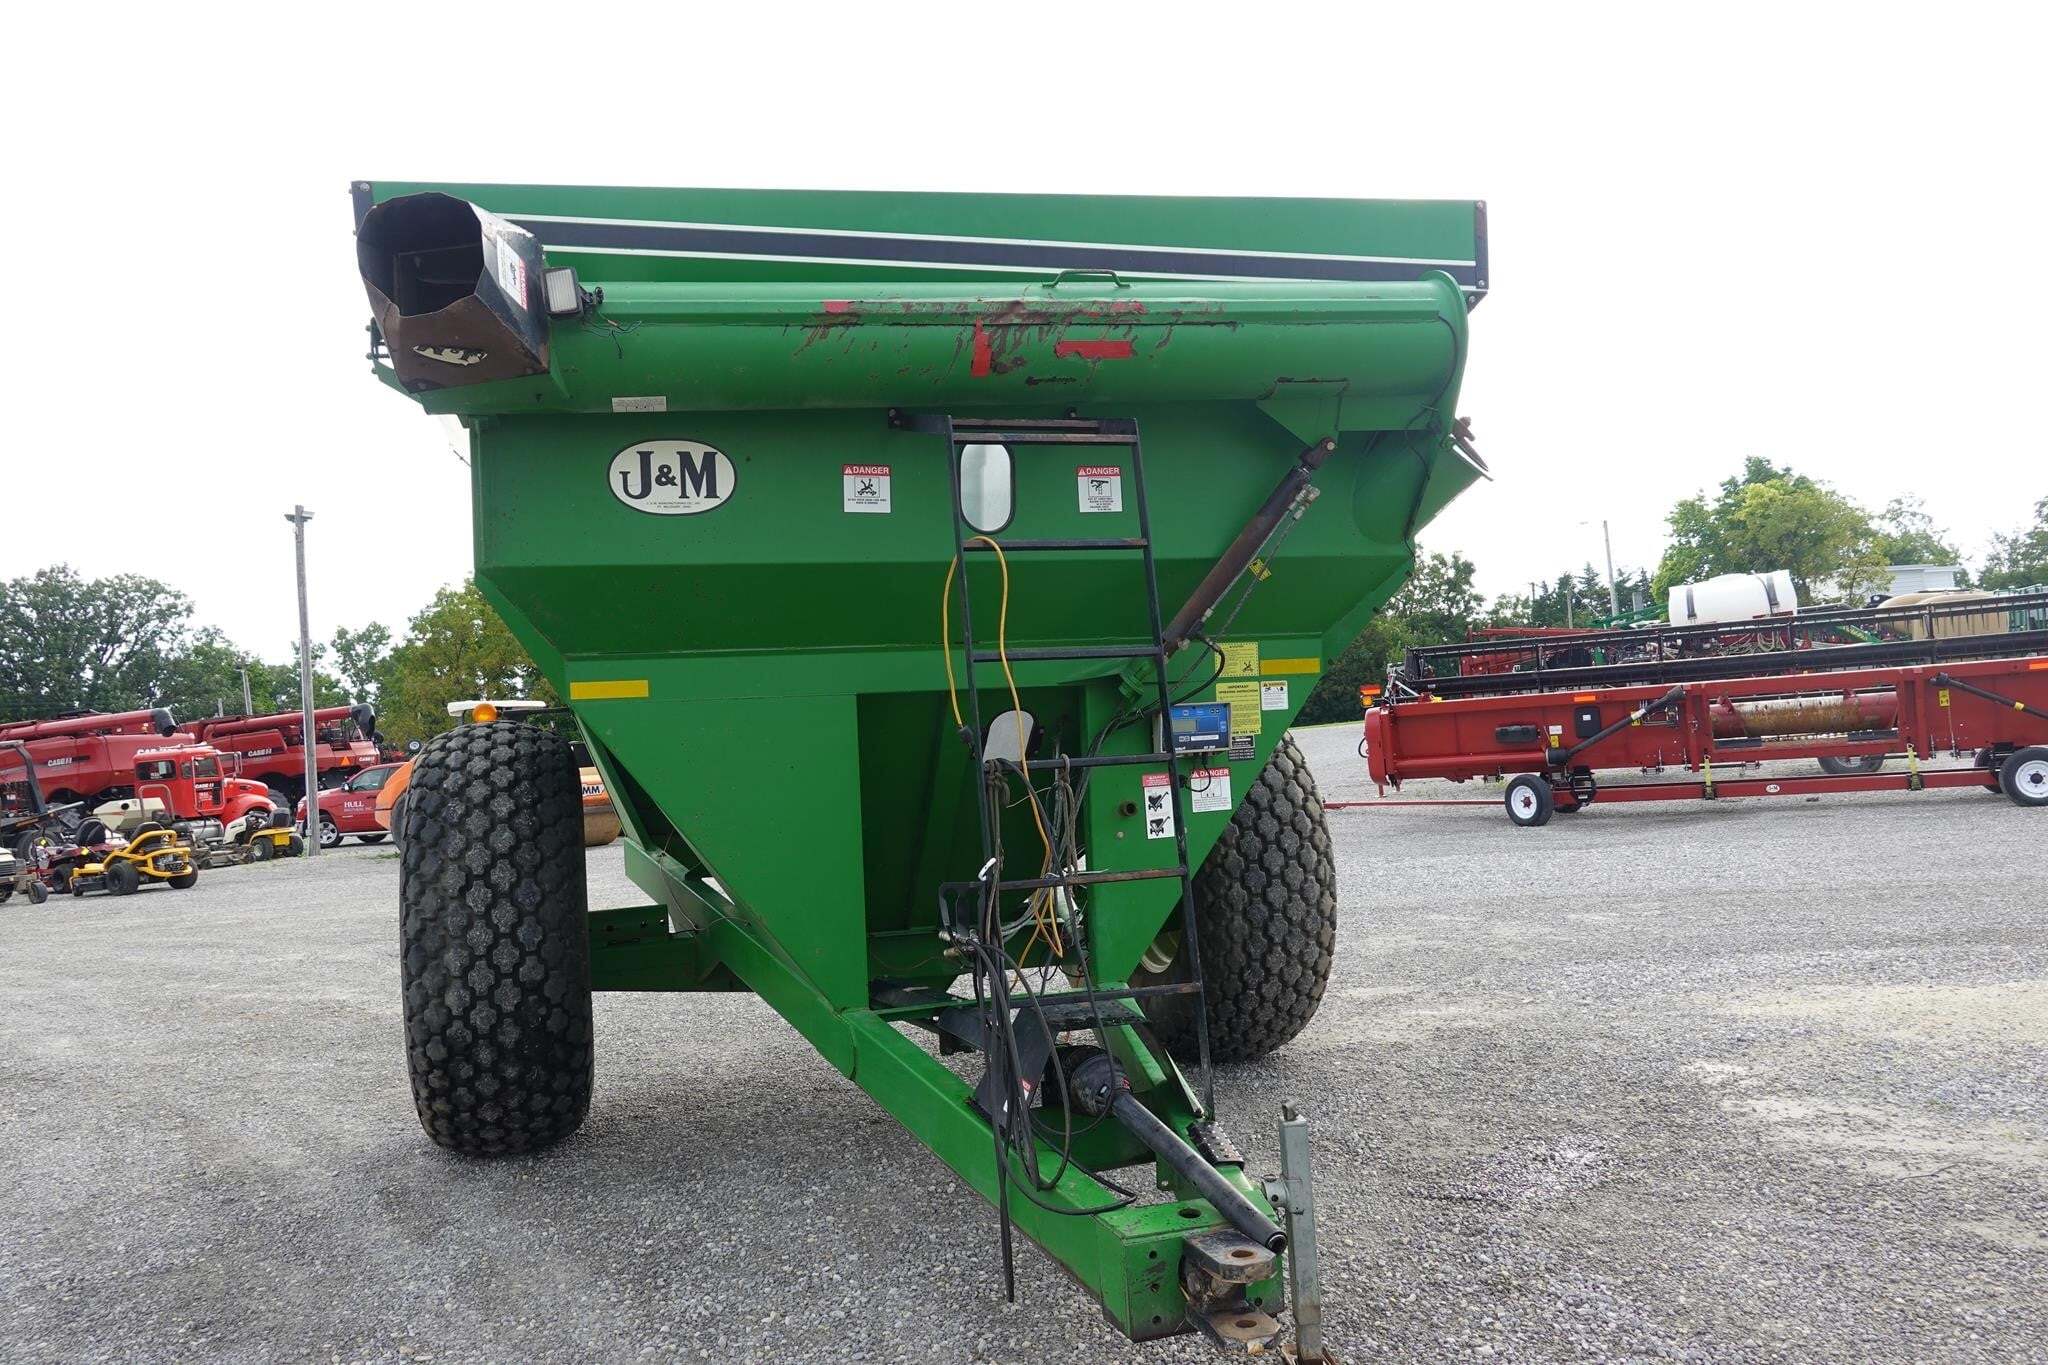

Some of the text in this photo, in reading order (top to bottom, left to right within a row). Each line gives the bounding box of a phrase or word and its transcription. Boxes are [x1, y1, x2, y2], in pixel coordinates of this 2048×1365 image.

[853, 466, 889, 475] DANGER
[1086, 467, 1120, 475] DANGER
[619, 451, 721, 500] J&M
[1200, 769, 1229, 777] DANGER
[582, 785, 600, 794] MM
[344, 800, 364, 808] HULL
